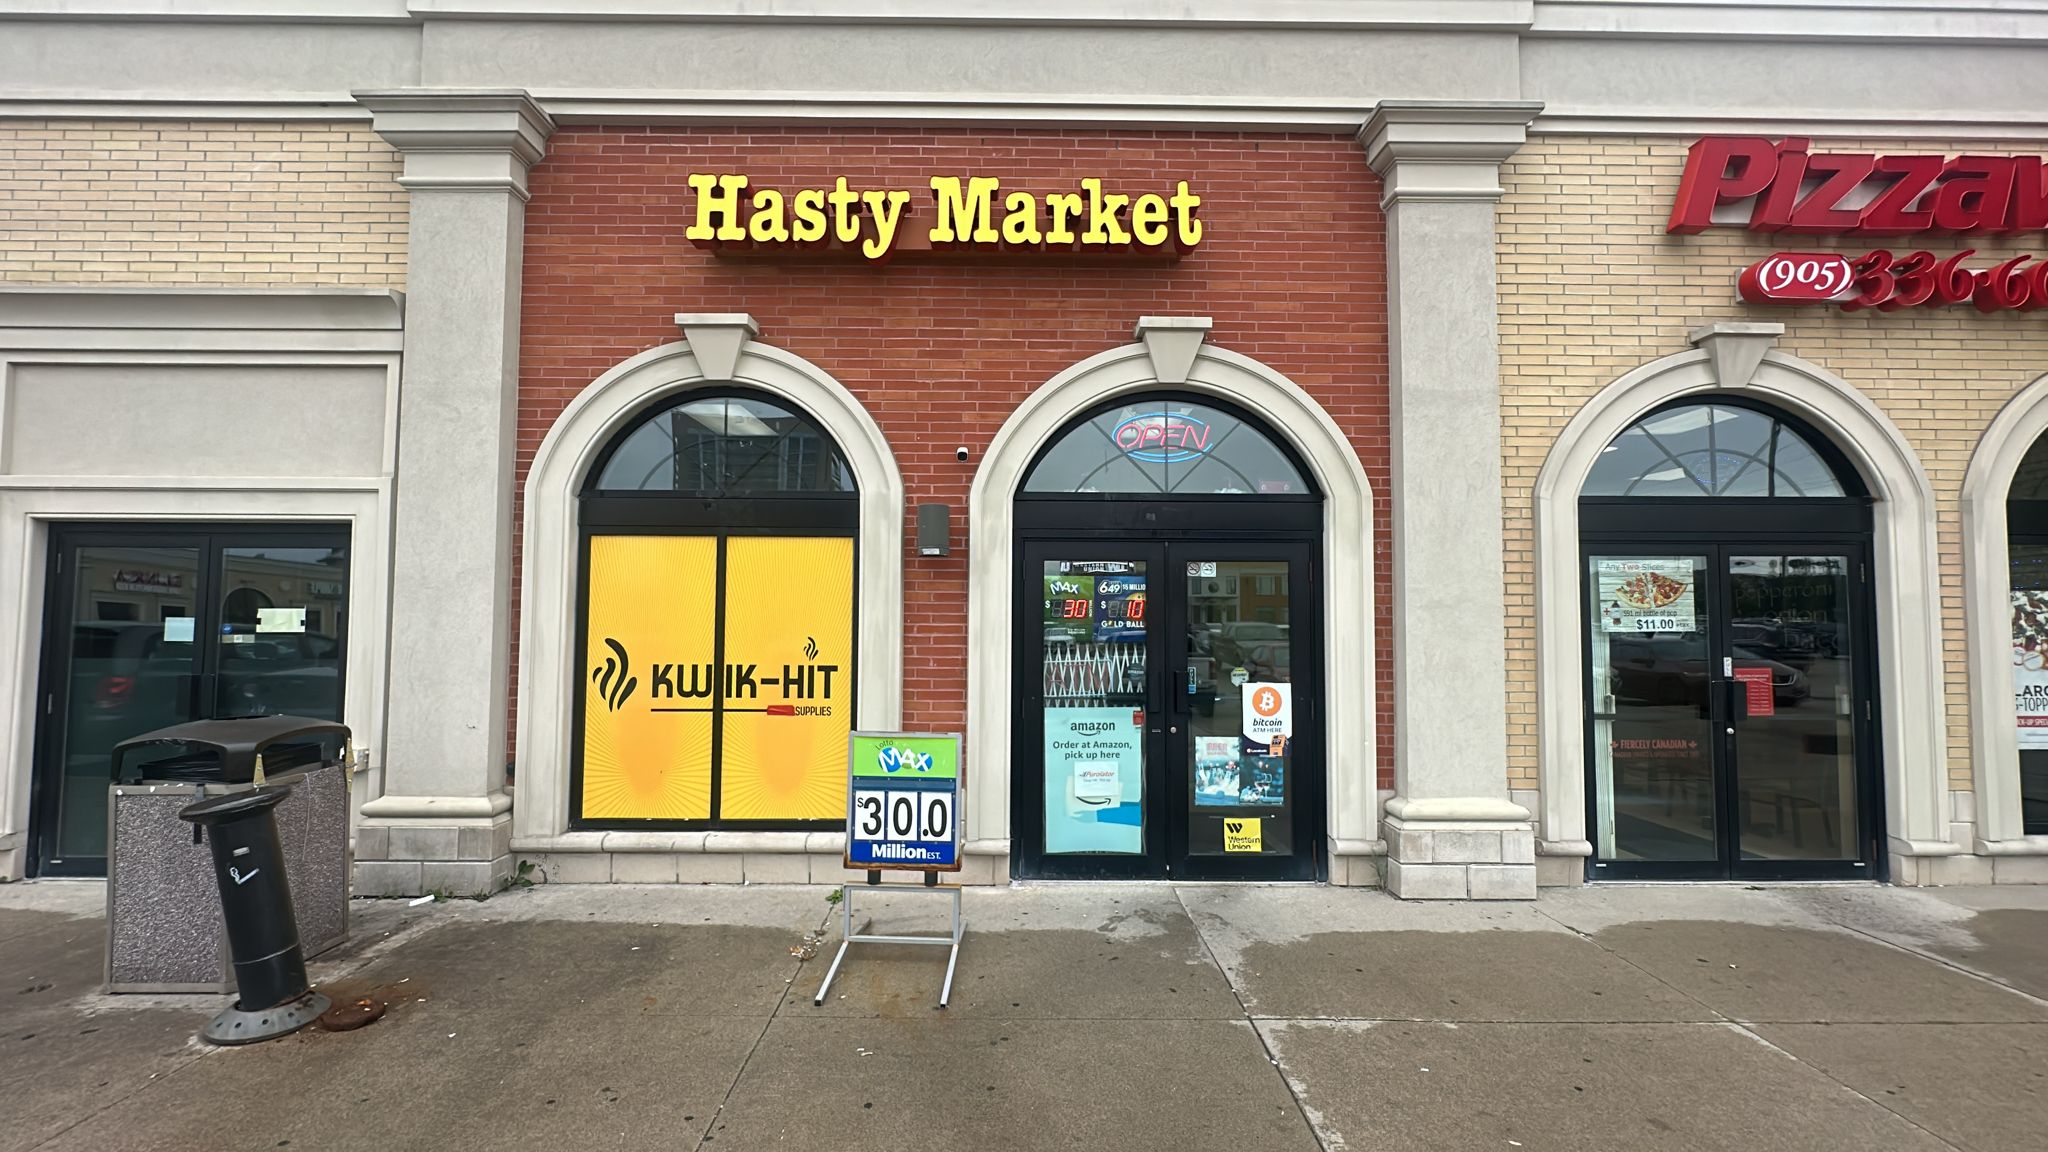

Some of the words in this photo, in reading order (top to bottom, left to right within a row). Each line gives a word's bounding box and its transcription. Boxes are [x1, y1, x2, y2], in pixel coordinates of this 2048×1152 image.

[685, 174, 911, 260] Hasty
[929, 176, 1203, 246] Market
[1758, 257, 1852, 294] (905)
[1117, 423, 1211, 450] OPEN
[1605, 563, 1619, 571] Any
[1621, 563, 1640, 571] Two
[1641, 563, 1664, 571] Slices
[1050, 581, 1079, 595] MAX
[1063, 600, 1088, 618] 30
[1127, 600, 1145, 618] 10
[1126, 620, 1145, 628] BALL
[1636, 619, 1674, 630] $11.00
[651, 664, 838, 699] KWIK-HIT
[795, 706, 831, 716] SUPPLIES
[1070, 721, 1116, 731] amazon
[1253, 718, 1282, 727] bitcoin
[876, 740, 894, 751] Lotto
[1053, 741, 1079, 749] Order
[1081, 741, 1091, 749] at
[1094, 741, 1133, 750] Amazon,
[1620, 739, 1650, 749] FIERCELY
[1652, 739, 1687, 749] CANADIAN
[878, 747, 931, 773] MAX
[1064, 751, 1084, 760] pick
[1086, 752, 1098, 760] up
[1100, 751, 1121, 759] here
[1228, 836, 1260, 844] Western
[872, 844, 927, 859] Million
[927, 851, 942, 860] EST.
